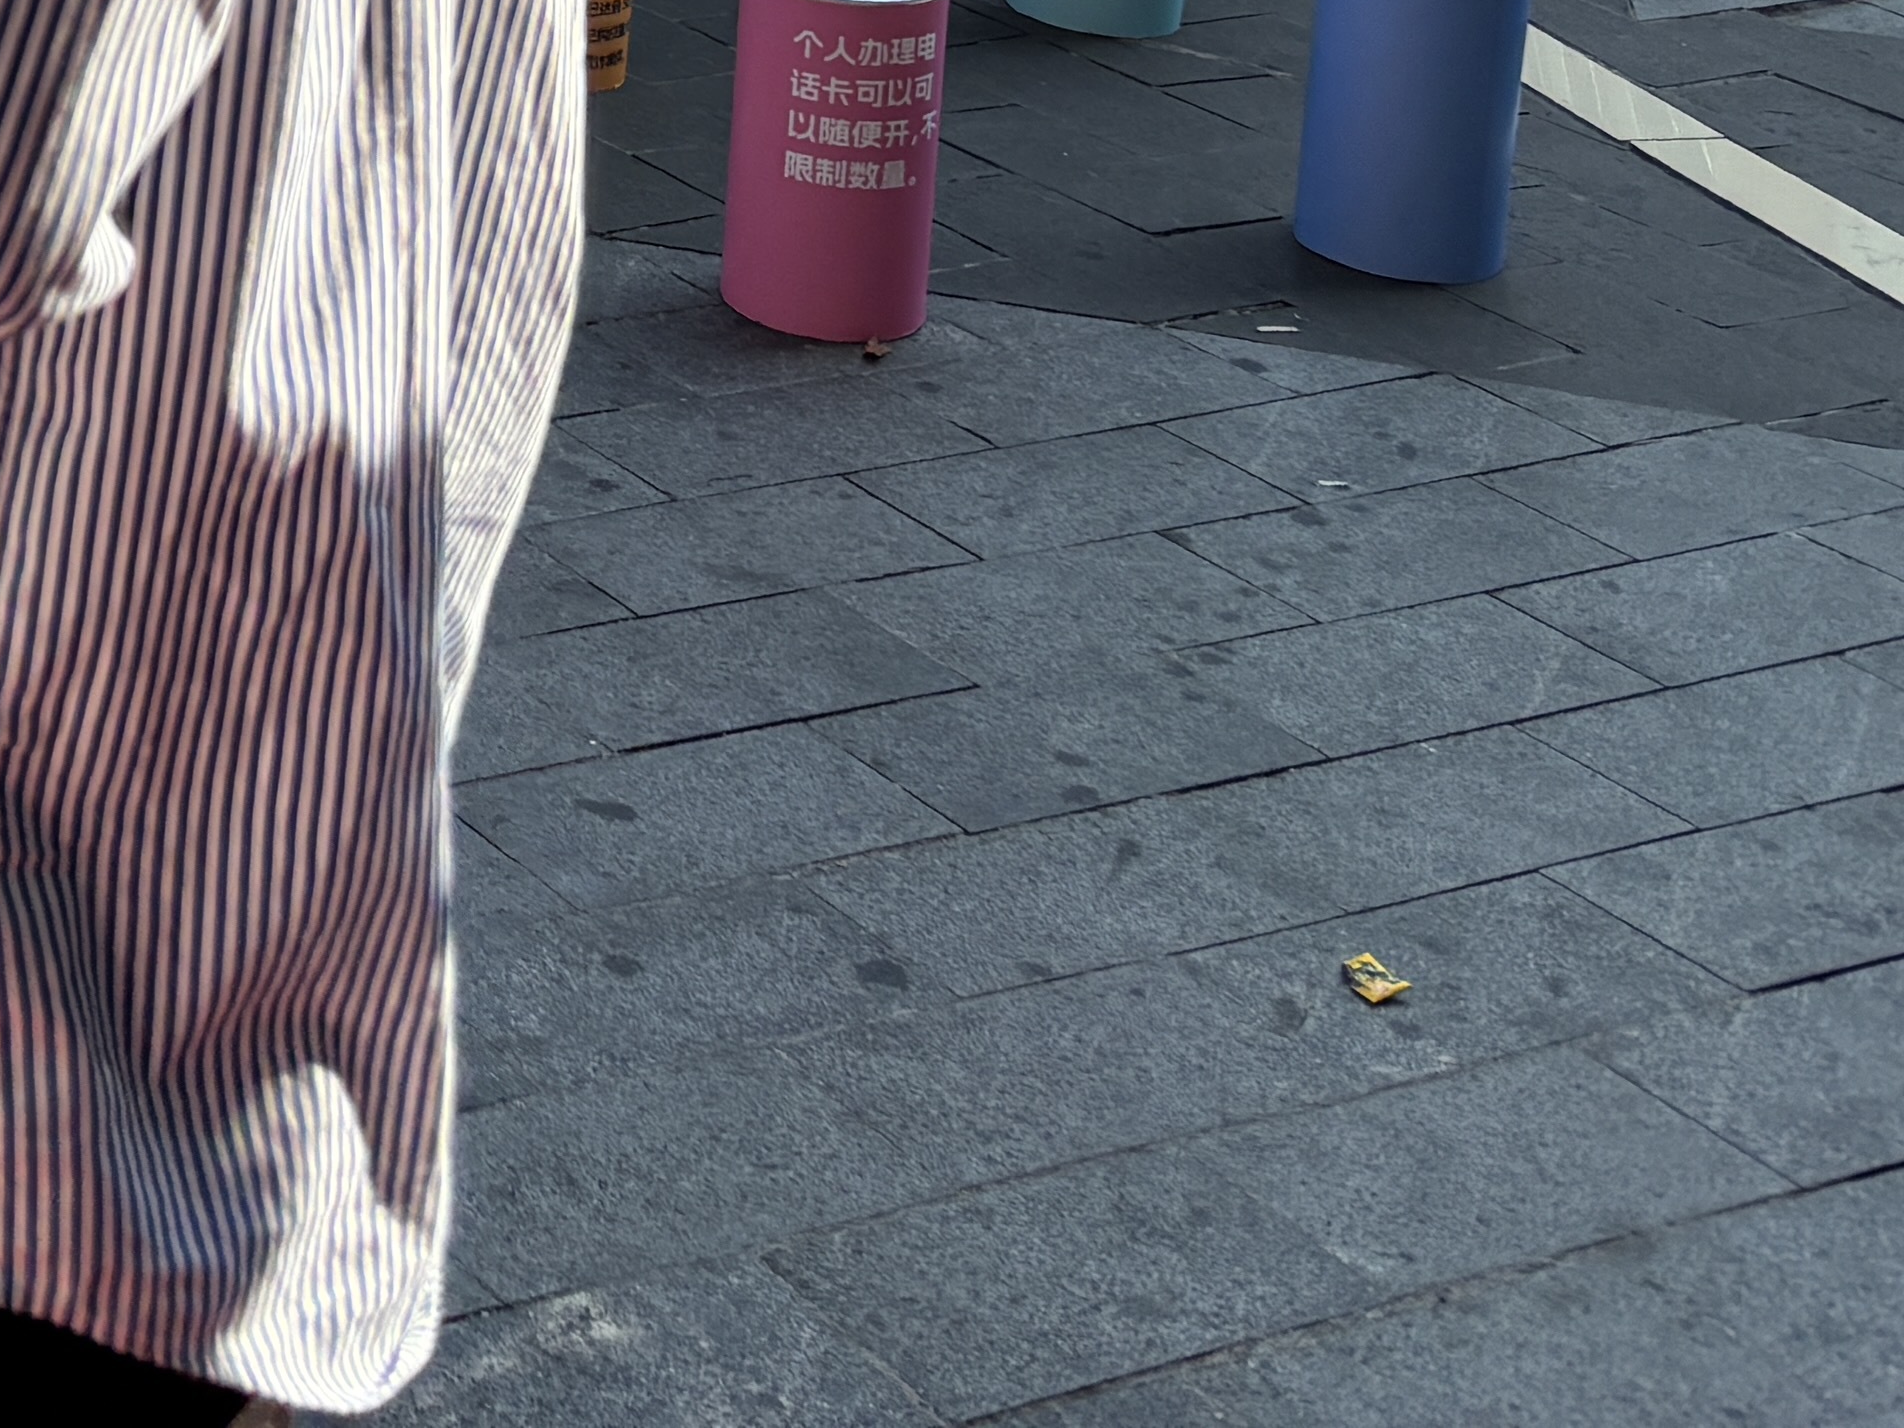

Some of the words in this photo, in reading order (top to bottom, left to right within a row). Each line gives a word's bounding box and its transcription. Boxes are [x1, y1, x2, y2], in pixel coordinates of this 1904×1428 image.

[793, 29, 937, 67] 个人办理电
[789, 67, 935, 109] 话卡可以可
[783, 149, 918, 191] 限制数量。
